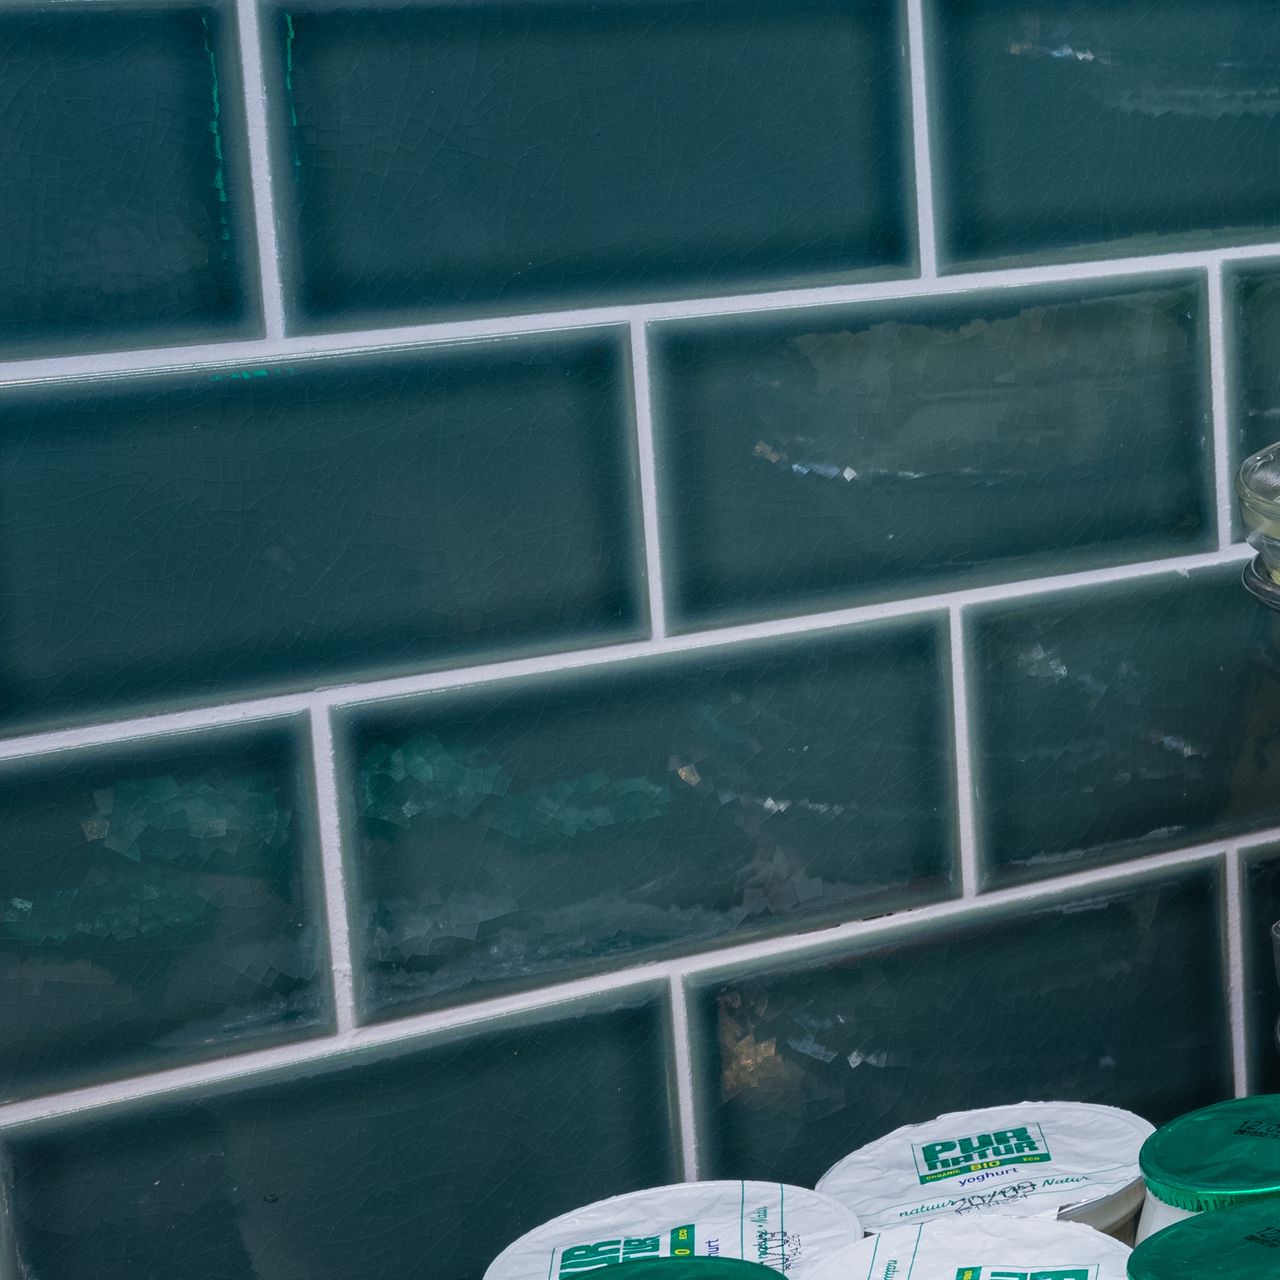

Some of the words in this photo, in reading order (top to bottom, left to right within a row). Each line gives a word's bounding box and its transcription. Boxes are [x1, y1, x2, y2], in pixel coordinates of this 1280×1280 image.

[921, 1126, 1033, 1163] PUR
[927, 1140, 1039, 1172] NATUR
[958, 1167, 1019, 1187] yoghurt
[969, 1159, 1001, 1172] BIO
[1022, 1155, 1040, 1163] ECO
[899, 1199, 955, 1217] natuur
[1042, 1174, 1091, 1188] Natur
